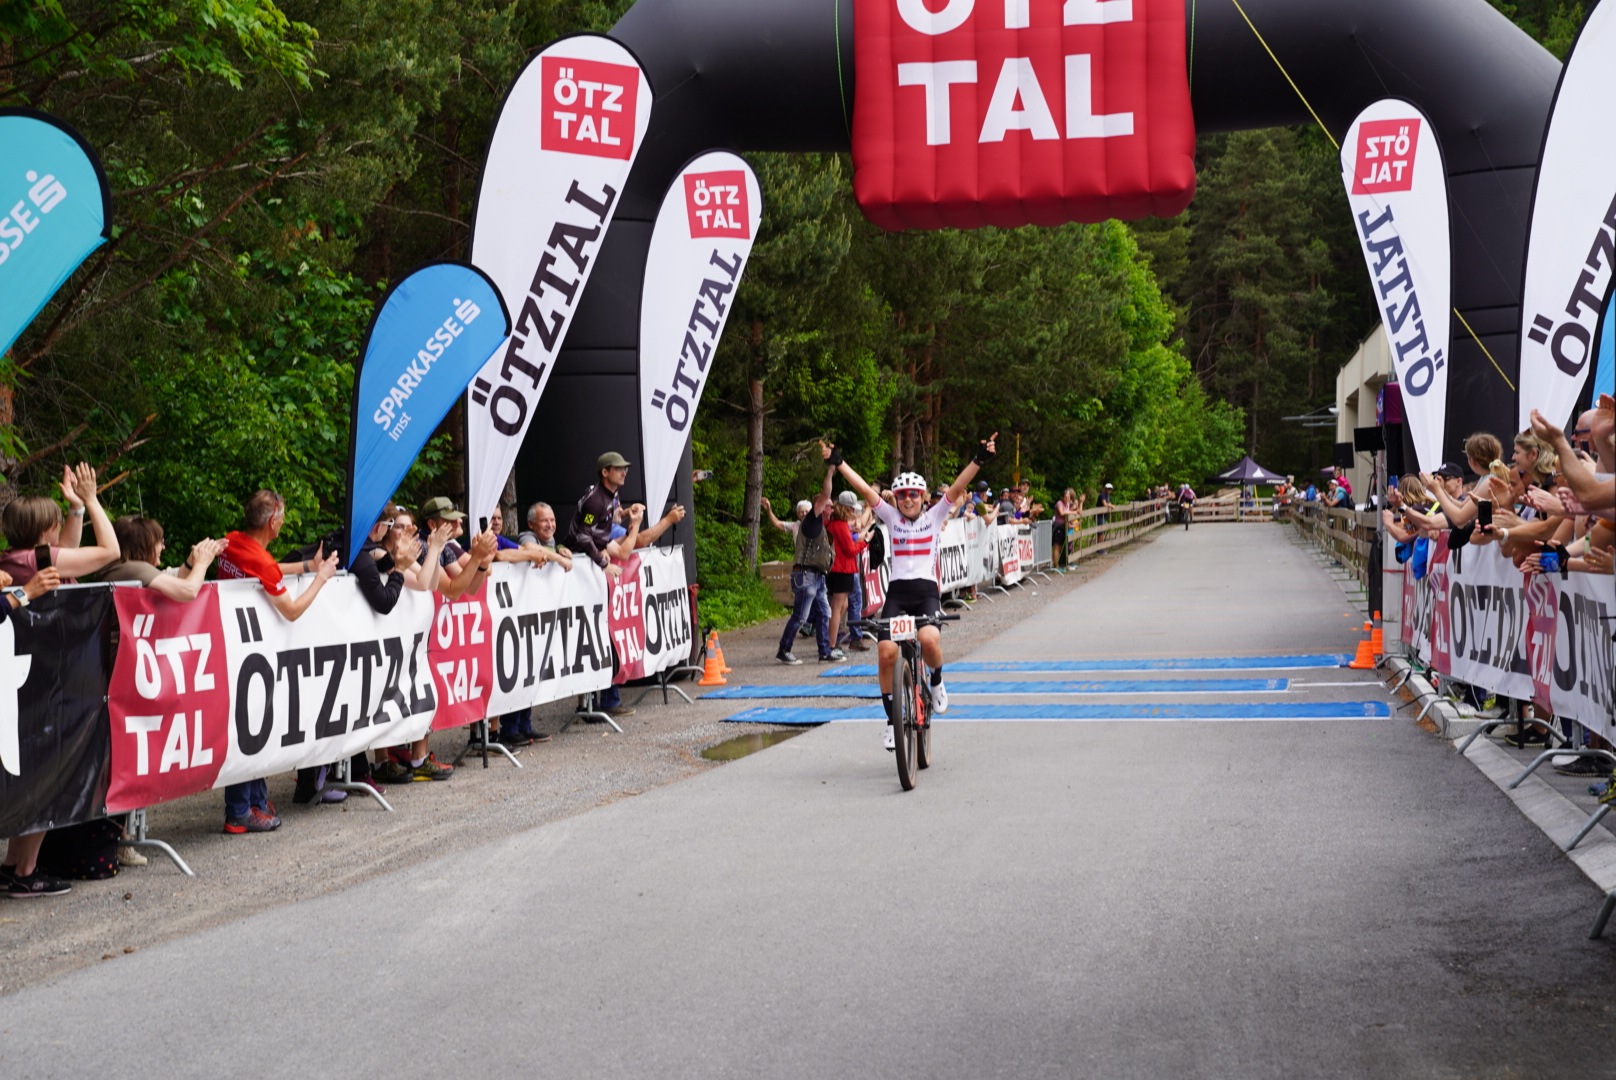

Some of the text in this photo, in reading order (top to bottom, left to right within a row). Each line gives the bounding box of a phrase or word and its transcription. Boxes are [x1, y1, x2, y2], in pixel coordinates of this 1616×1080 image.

[553, 67, 624, 113] ÖTZ
[897, 53, 1134, 146] TAL
[553, 111, 621, 146] TAL
[693, 179, 740, 206] ÖTZ
[695, 208, 741, 229] TAL
[471, 179, 617, 436] ÖTZTAL
[650, 248, 743, 432] ÖTZTAL
[373, 316, 464, 431] SPARKASSE
[388, 411, 412, 442] Imst
[437, 593, 485, 650] ÖTZ
[612, 576, 639, 621] ÖTZ
[496, 581, 613, 694] ÖTZTAL
[614, 627, 644, 665] TAL
[892, 619, 913, 634] 201
[132, 614, 216, 700] ÖTZ
[235, 606, 436, 757] ÖTZTAL
[436, 657, 484, 706] TAL
[124, 709, 214, 776] TAL
